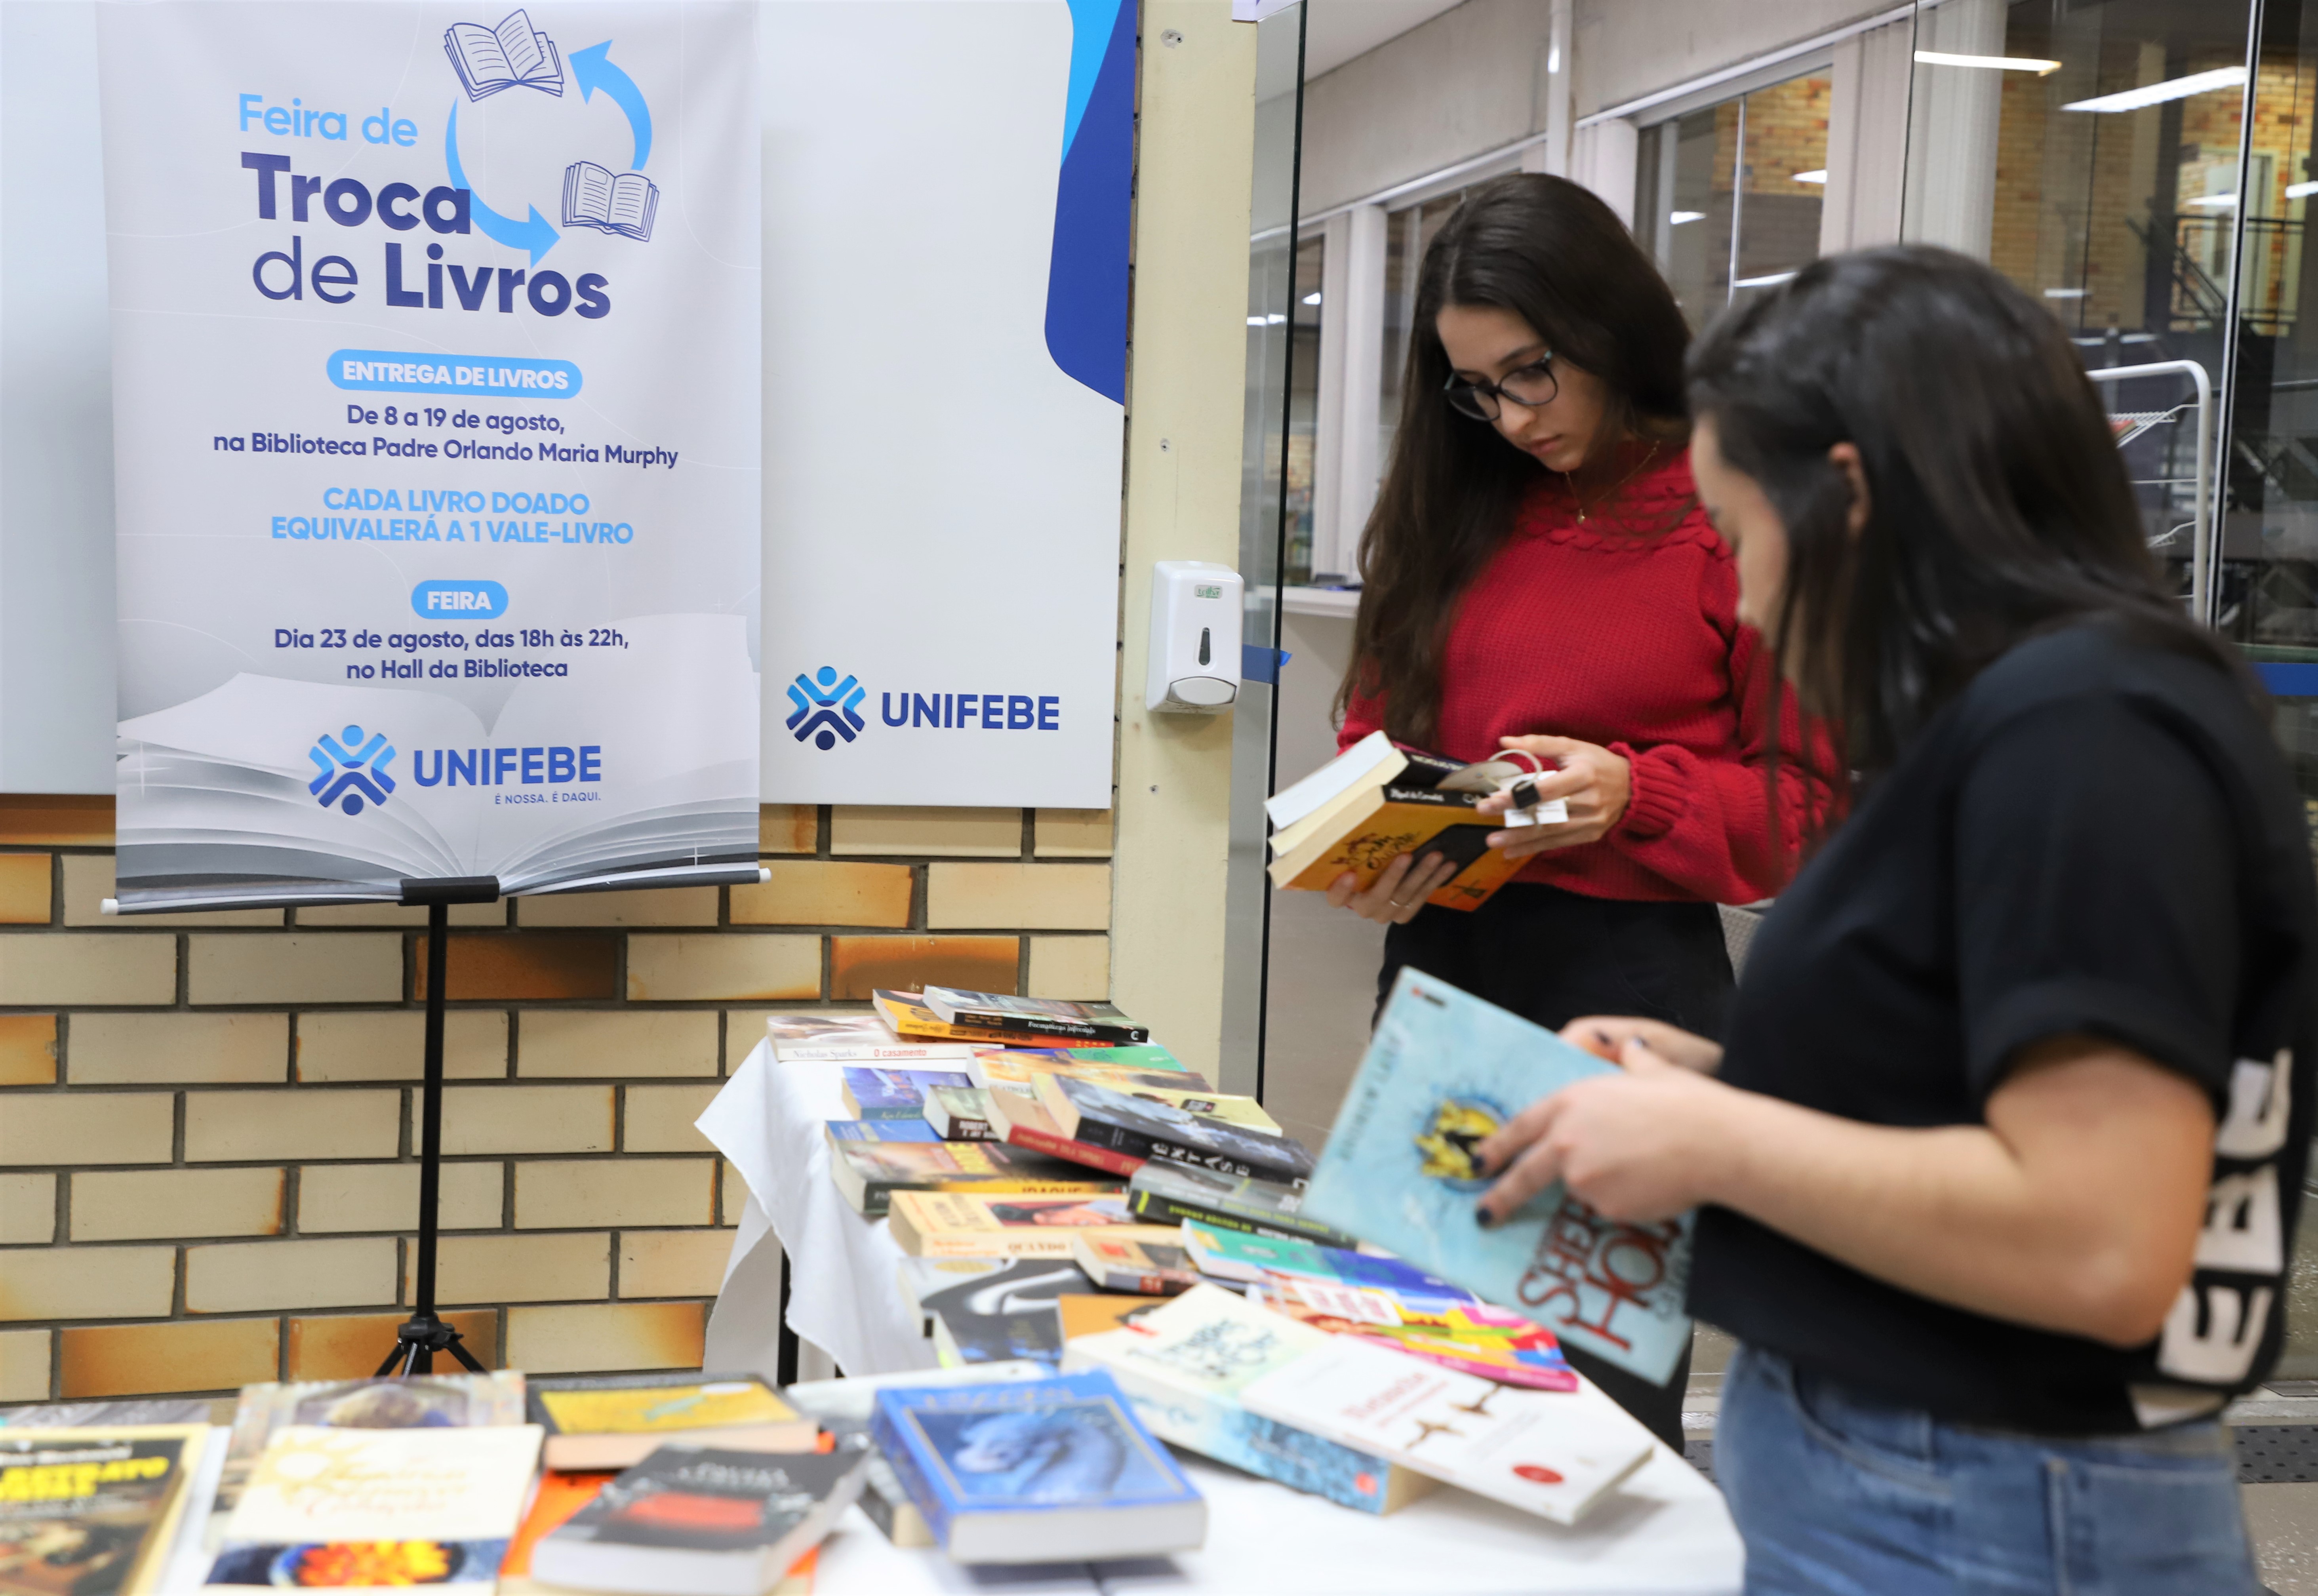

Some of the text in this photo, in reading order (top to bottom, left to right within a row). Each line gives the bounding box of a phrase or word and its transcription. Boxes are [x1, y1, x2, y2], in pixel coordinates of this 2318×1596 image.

[240, 94, 417, 147] Feira de
[240, 152, 470, 234] Troca
[253, 236, 609, 318] de Livros
[343, 361, 568, 389] ENTREGA DE LIVROS
[348, 405, 564, 434] De 8 a 19 de agosto,
[214, 433, 678, 469] na Biblioteca Padre Orlando Maria Murphy
[324, 488, 589, 515] CADA LIVRO DOADO
[272, 514, 633, 544] EQUIVALERÁ A 1 VALE-LIVRO
[428, 591, 492, 609] FEIRA
[275, 629, 628, 653] Dia 23 de agosto, das 18h às 22h,
[347, 659, 567, 678] no Hall da Biblioteca
[882, 693, 1059, 730] UNIFEBE
[414, 746, 600, 787] UNIFEBE
[495, 791, 601, 804] É NOSSA. É DAQUI.
[793, 1048, 927, 1059] Nicholas Sparks O casamento
